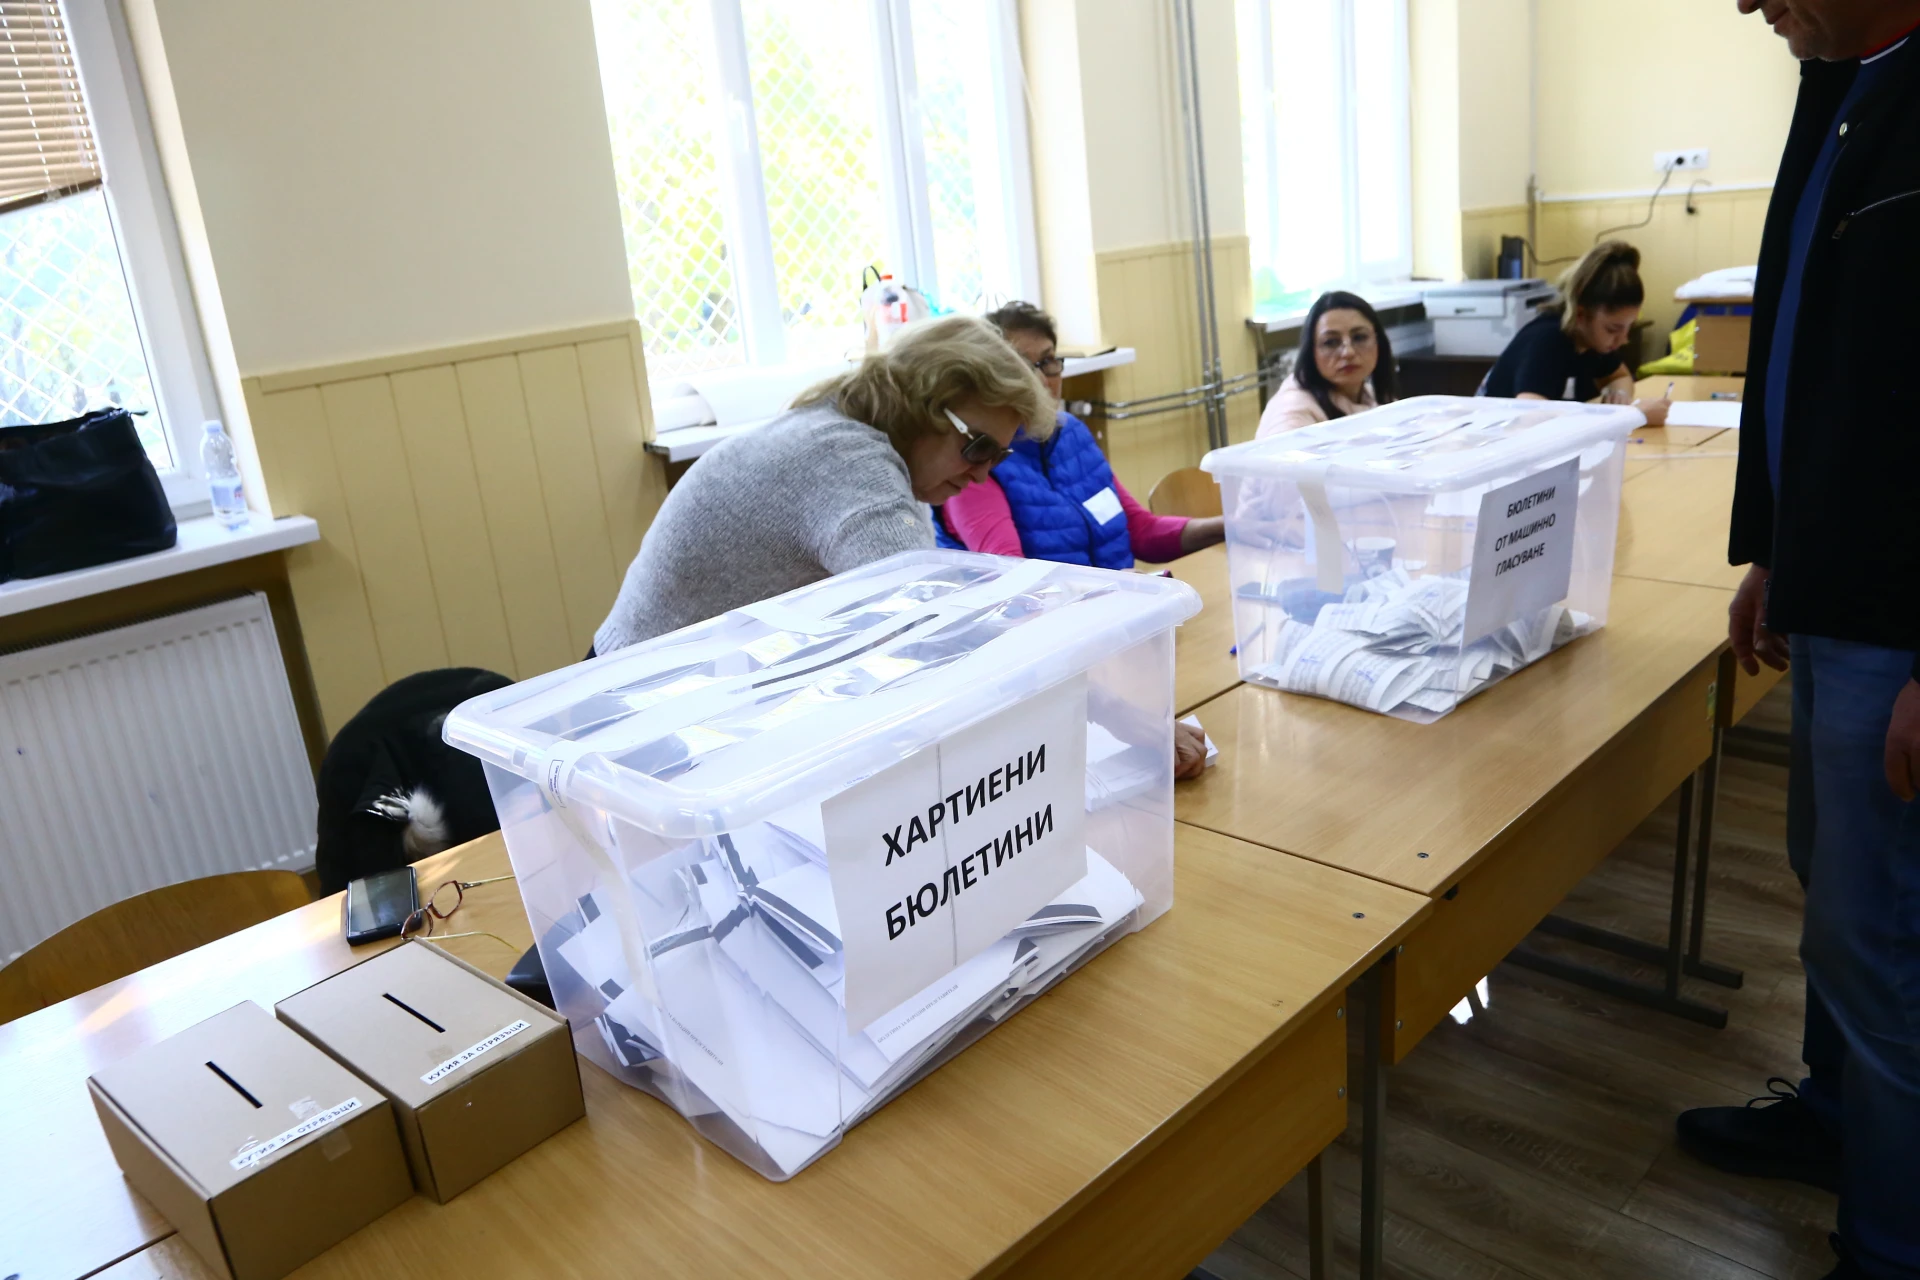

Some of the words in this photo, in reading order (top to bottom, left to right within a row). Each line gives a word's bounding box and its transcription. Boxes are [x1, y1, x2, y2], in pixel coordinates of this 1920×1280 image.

[1507, 486, 1556, 518] БЮЛЕТИНИ
[1495, 534, 1509, 552] ОТ
[1508, 513, 1556, 545] МАШИННО
[1495, 542, 1546, 577] ГЛАСУВАНЕ
[881, 743, 1047, 867] ХАРТИЕНИ
[885, 803, 1055, 941] БЮЛЕТИНИ
[428, 1060, 460, 1081] КУТИЯ
[461, 1052, 475, 1061] ЗА
[476, 1022, 525, 1052] ОТРЯЗЪЦИ
[279, 1133, 294, 1143] ЗА
[297, 1101, 357, 1133] ОТРЯЗЪЦИ
